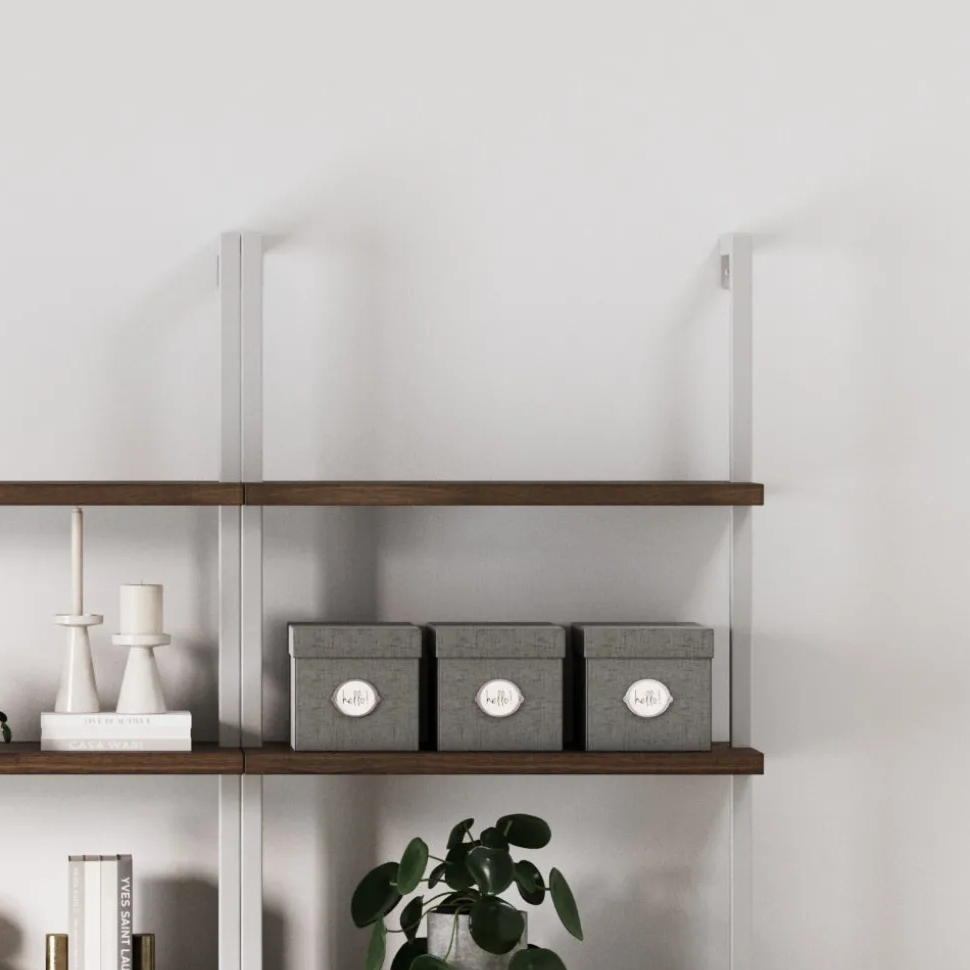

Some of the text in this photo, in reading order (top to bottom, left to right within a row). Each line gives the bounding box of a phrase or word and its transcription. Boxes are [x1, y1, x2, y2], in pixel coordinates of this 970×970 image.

[68, 740, 105, 751] CASA
[120, 876, 131, 907] YVES
[120, 910, 131, 946] SAINT
